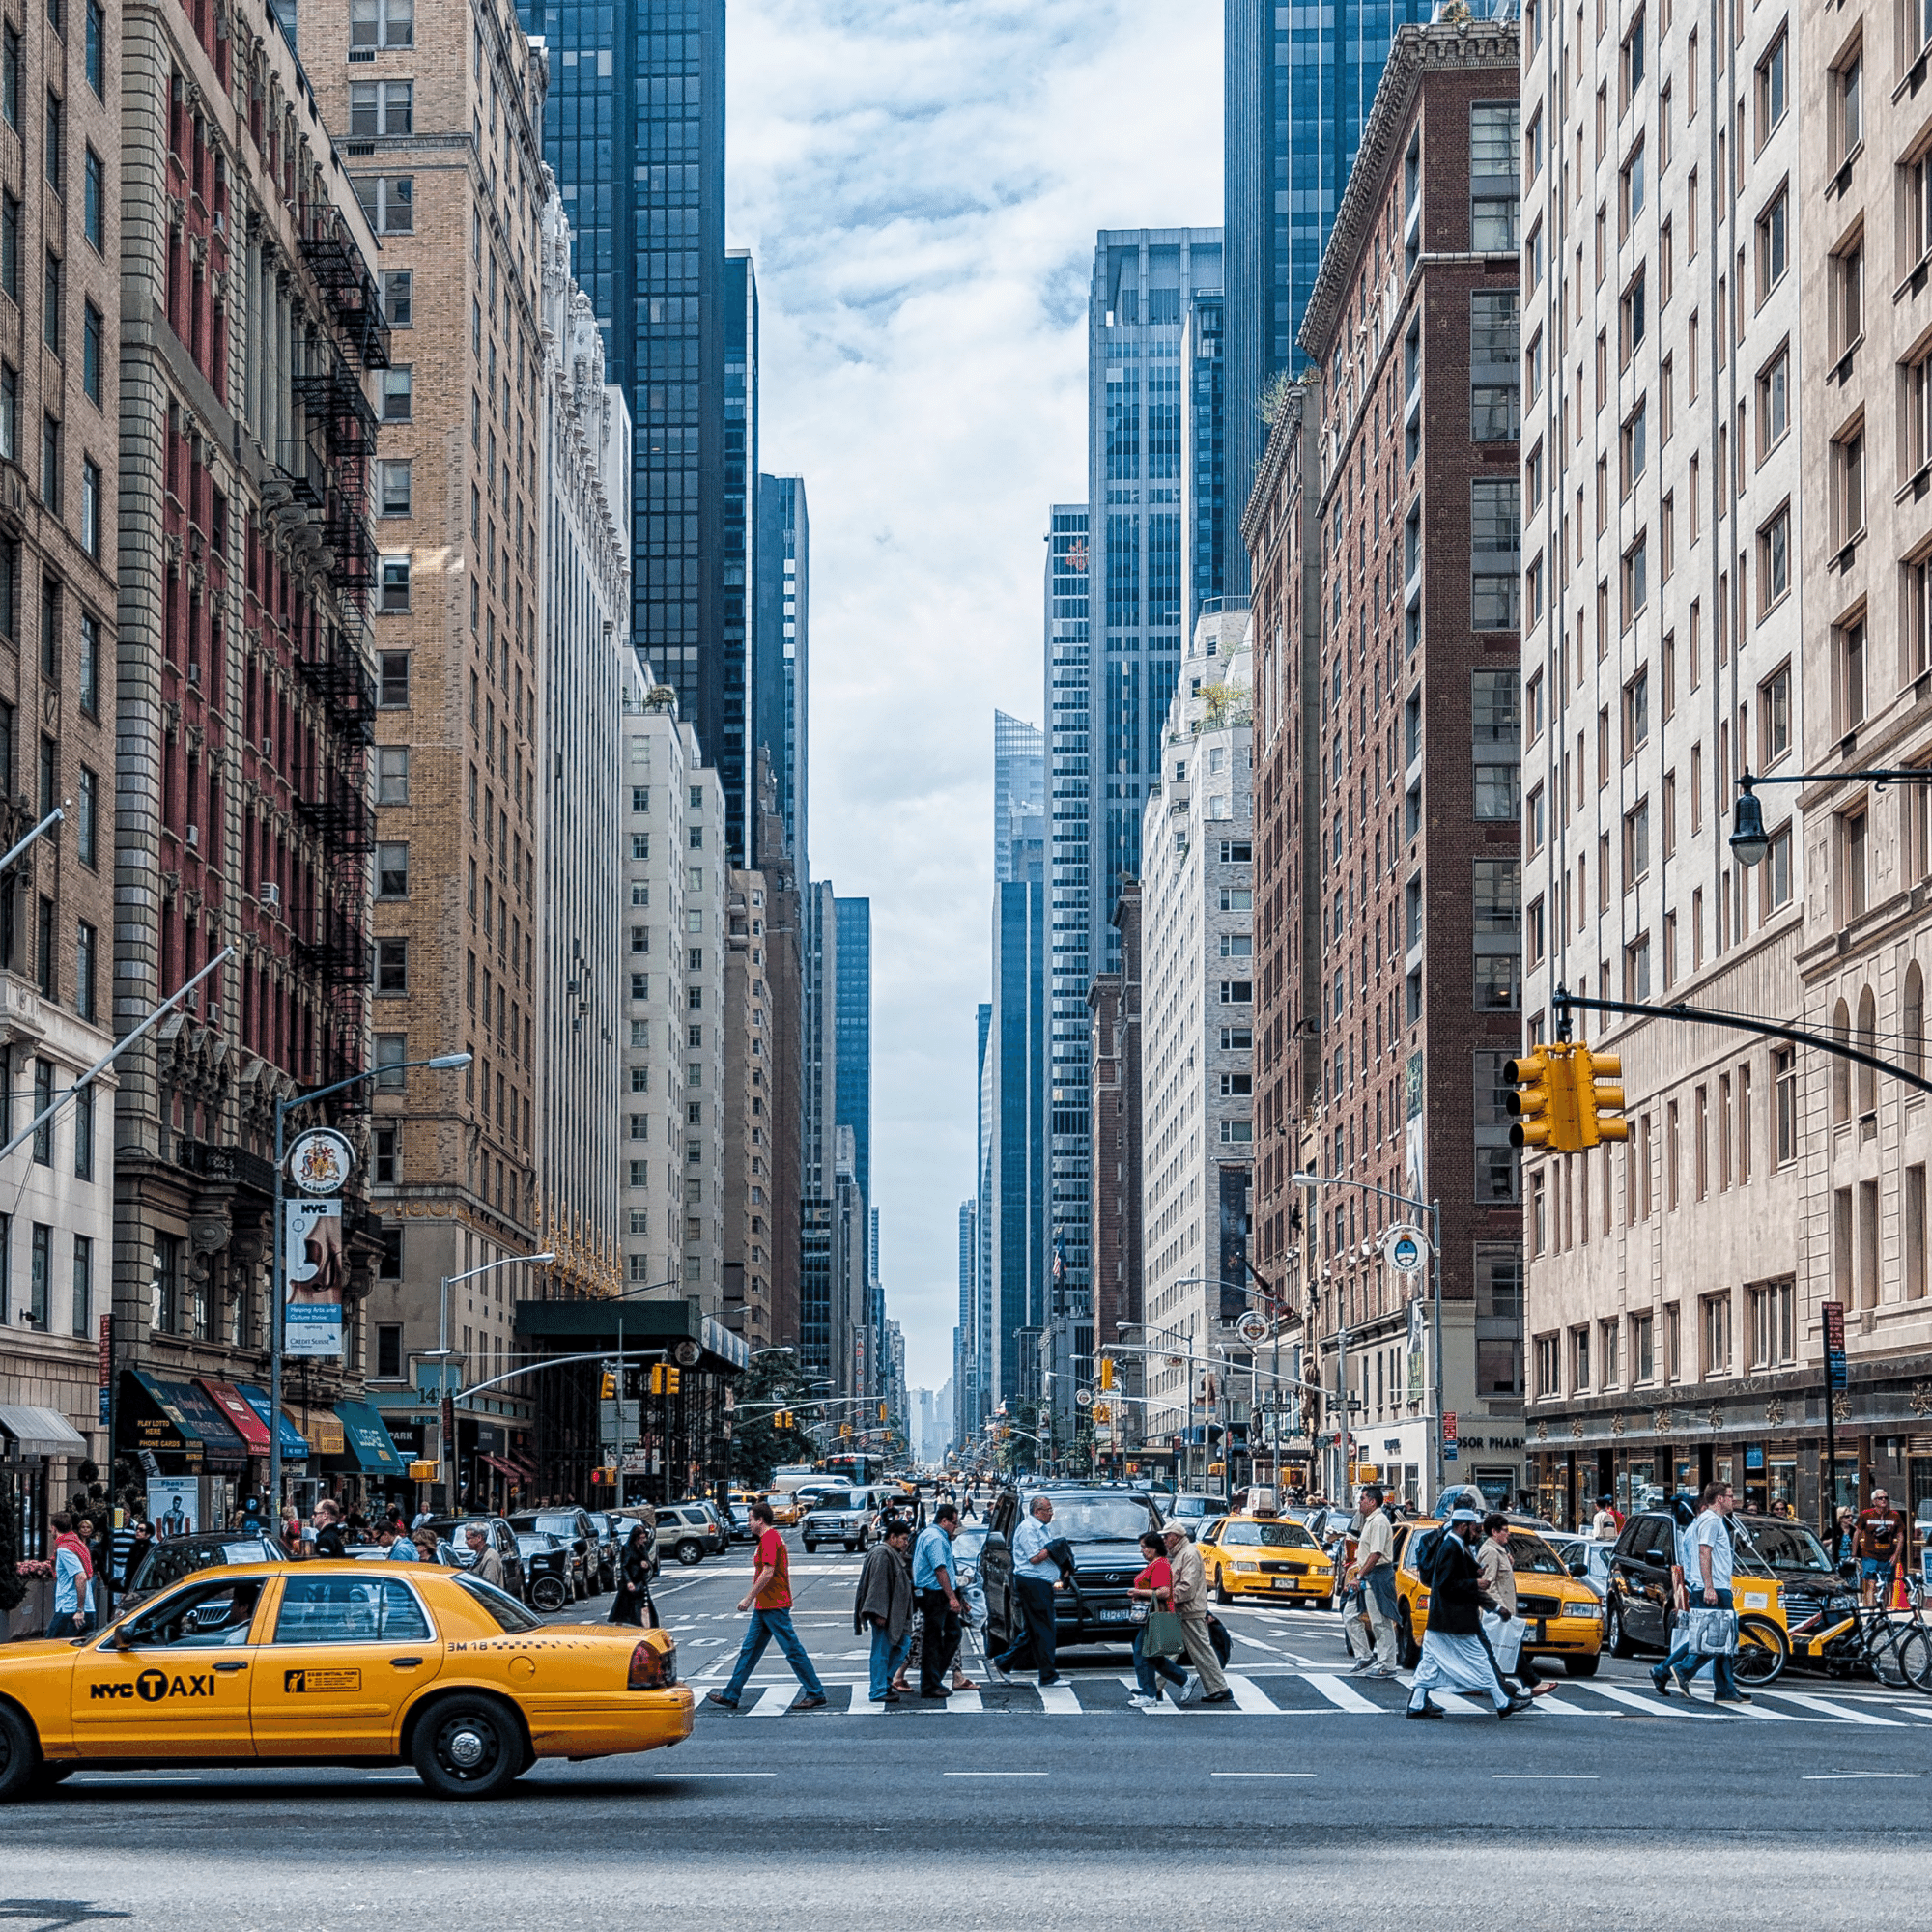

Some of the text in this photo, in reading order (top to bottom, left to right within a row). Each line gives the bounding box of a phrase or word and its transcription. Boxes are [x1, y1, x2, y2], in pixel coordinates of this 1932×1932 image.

[302, 1181, 338, 1193] BARBADOS
[301, 1204, 327, 1214] NYC
[388, 1432, 413, 1440] PARK
[90, 1669, 215, 1702] NYC TAXI
